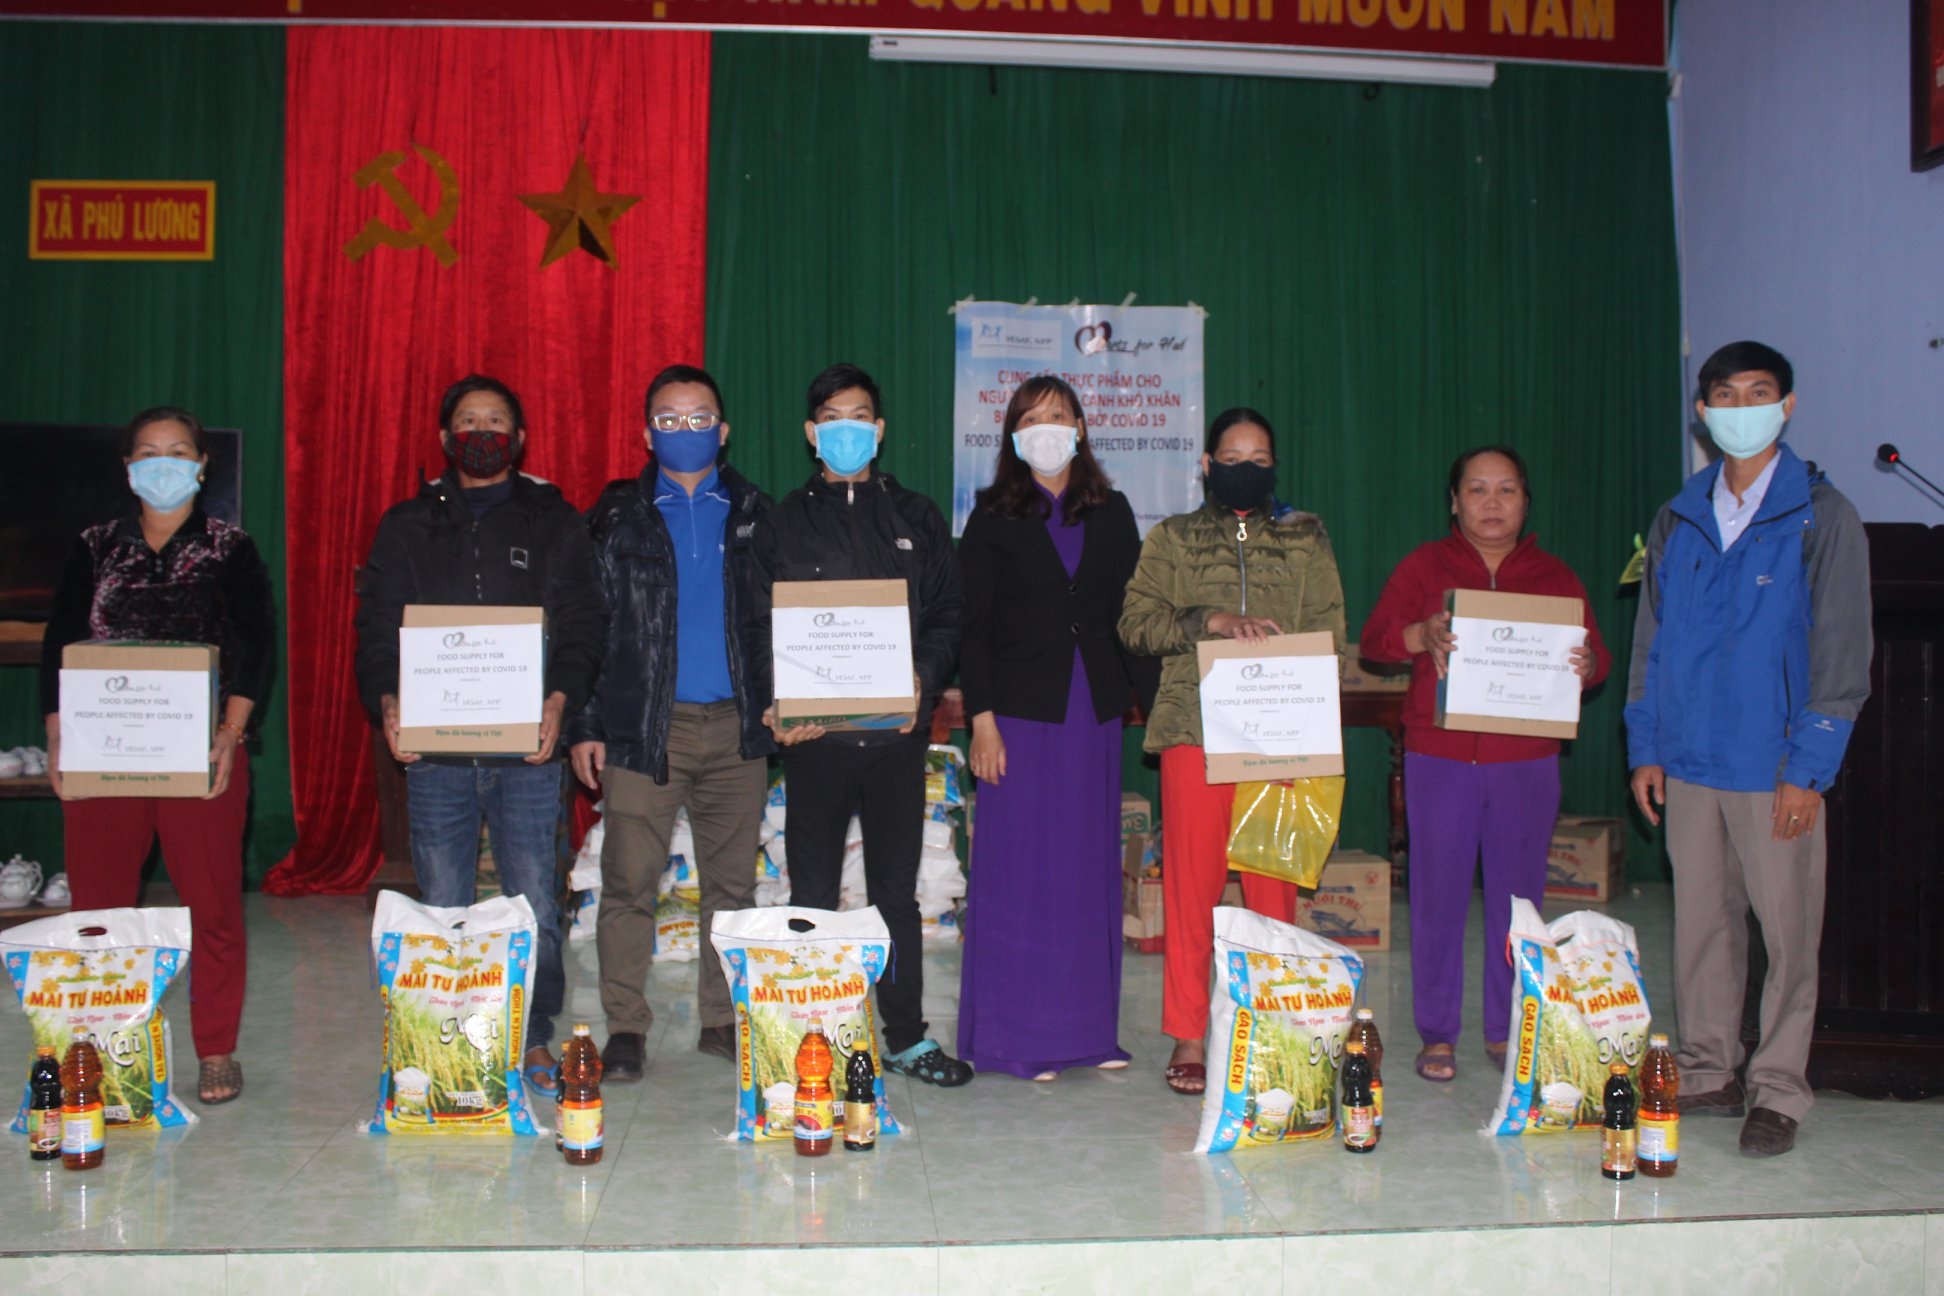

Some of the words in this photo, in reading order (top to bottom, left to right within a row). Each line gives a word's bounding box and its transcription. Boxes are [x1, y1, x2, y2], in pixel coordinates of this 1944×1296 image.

[43, 193, 74, 240] XÃ
[82, 193, 125, 240] PHÚ
[1136, 374, 1162, 387] CHO
[1111, 413, 1149, 427] COVID
[1152, 413, 1166, 427] 19
[965, 433, 992, 447] FOOD
[1137, 438, 1148, 450] BY
[1151, 437, 1180, 450] COVID
[1182, 438, 1194, 451] 19
[787, 644, 813, 652] PEOPLE
[1486, 646, 1506, 654] FOOD
[1508, 647, 1533, 656] SUPPLY
[1535, 649, 1549, 657] FOR
[437, 653, 458, 661] FOOD
[489, 652, 504, 660] FOR
[414, 667, 440, 675] PEOPLE
[443, 666, 479, 674] AFFECTED
[493, 665, 516, 673] COVID
[1463, 657, 1488, 666] PEOPLE
[1491, 660, 1525, 669] AFFECTED
[1537, 663, 1560, 671] COVID
[1236, 684, 1257, 692] FOOD
[1259, 684, 1286, 692] SUPPLY
[1288, 683, 1302, 691] FOR
[1214, 698, 1240, 706] PEOPLE
[1280, 697, 1289, 705] BY
[74, 711, 103, 719] PEOPLE
[106, 711, 142, 719] AFFECTED
[157, 712, 181, 720] COVID
[399, 973, 428, 989] MAI
[30, 991, 63, 1009] MAI
[753, 986, 783, 1003] MAI
[1255, 996, 1282, 1012] MAI
